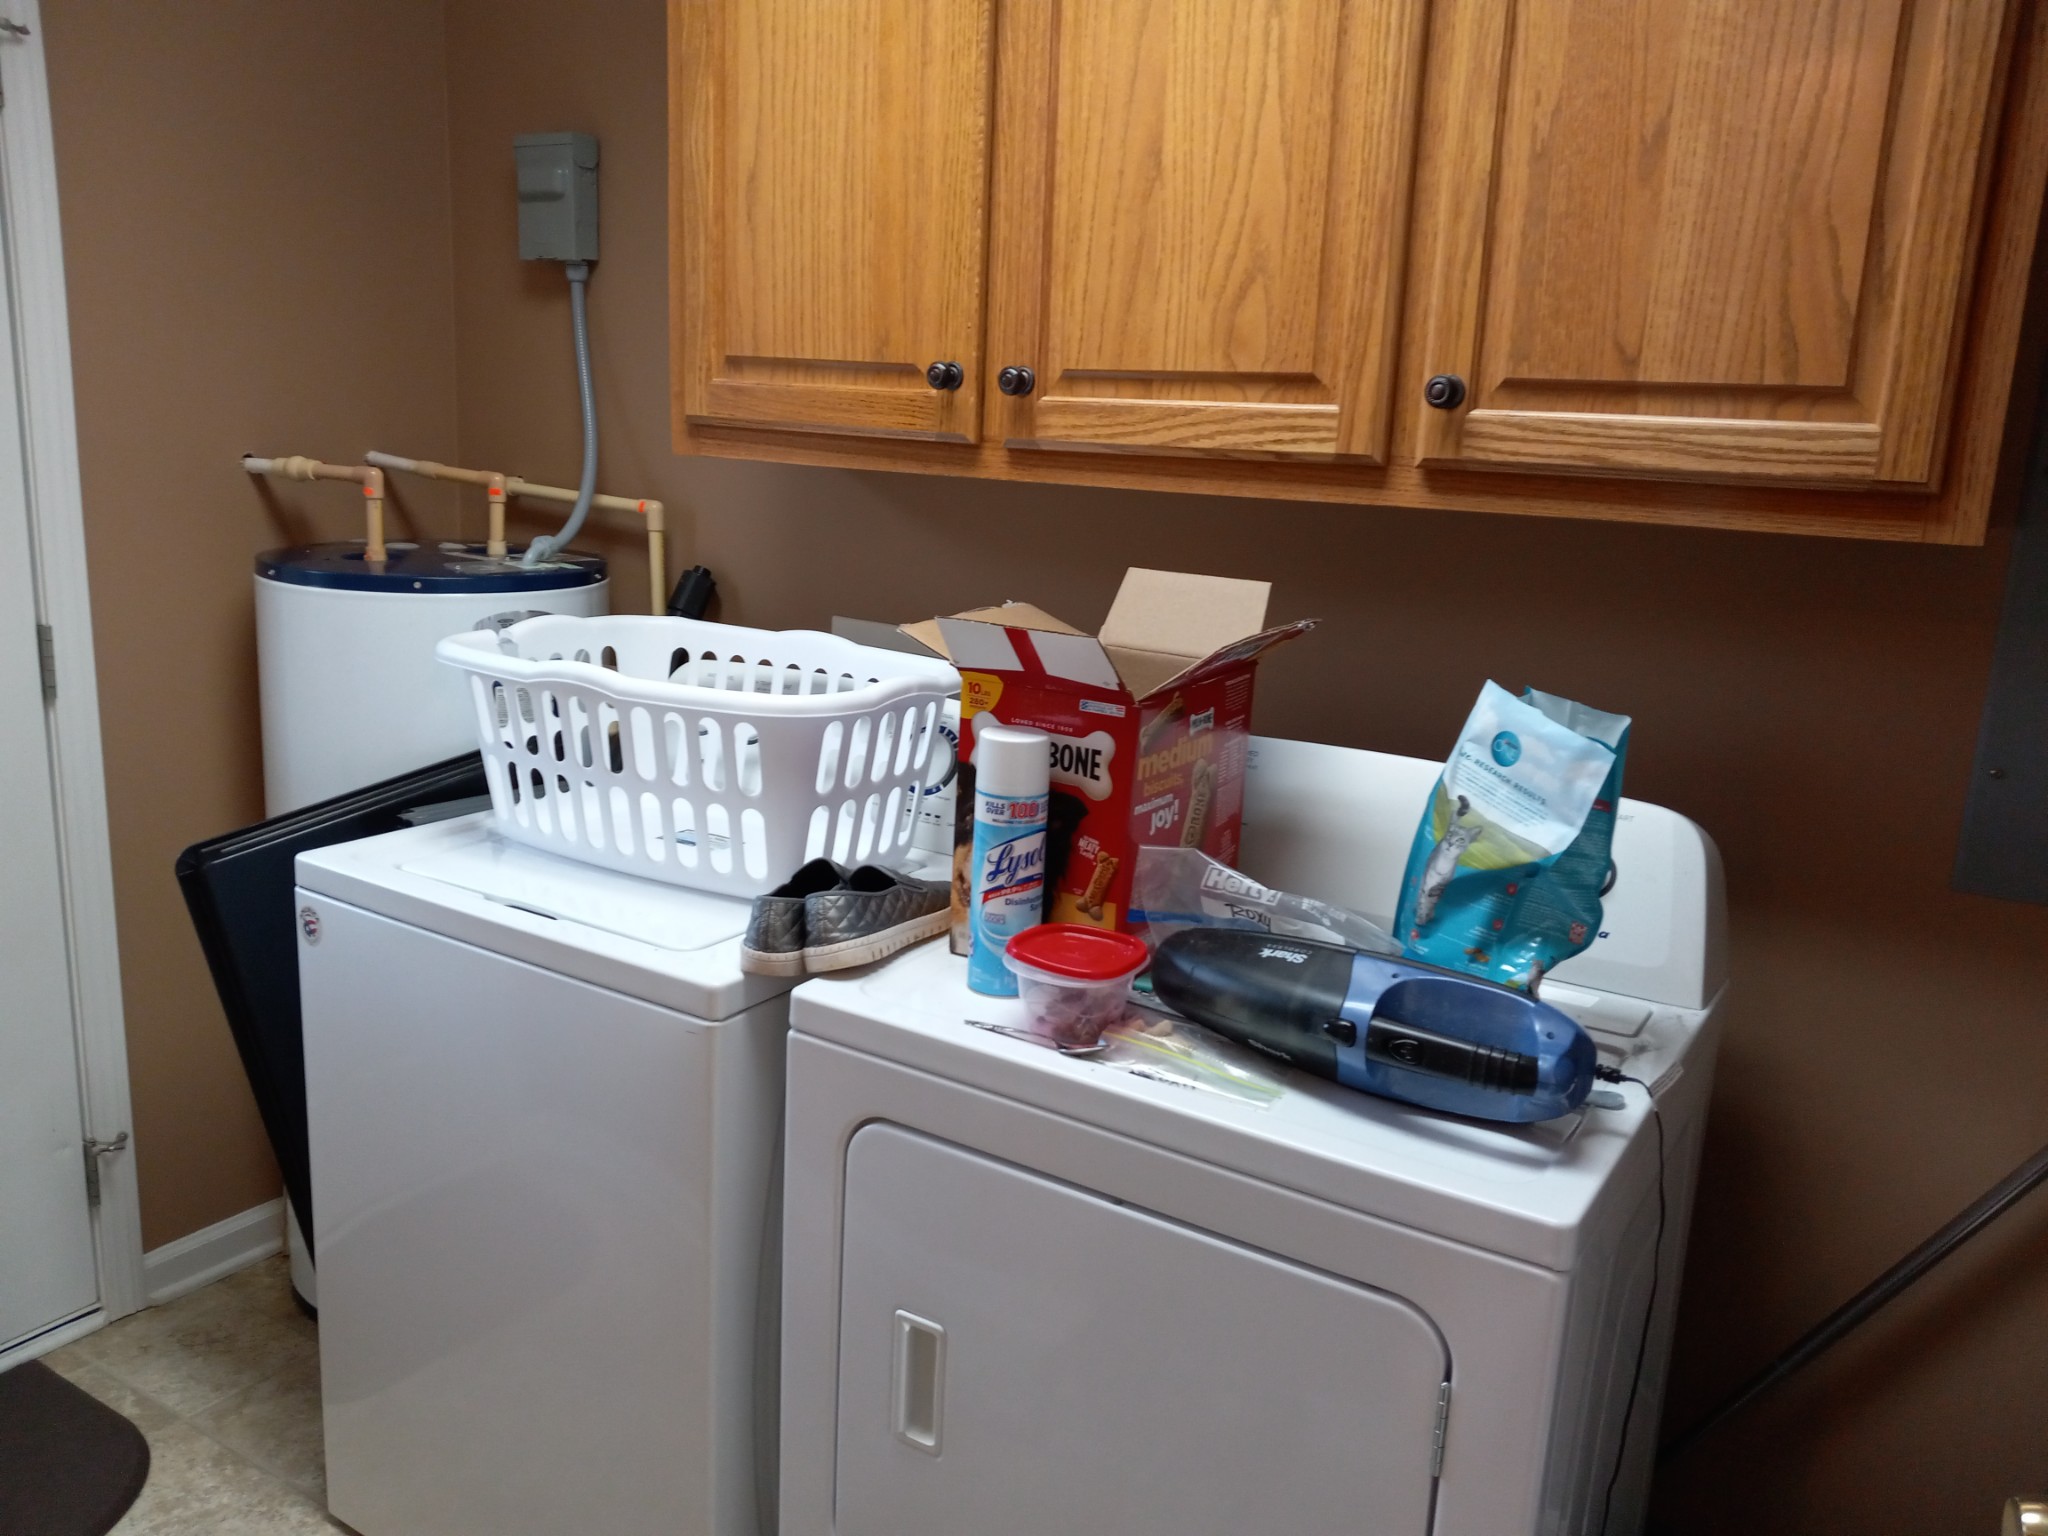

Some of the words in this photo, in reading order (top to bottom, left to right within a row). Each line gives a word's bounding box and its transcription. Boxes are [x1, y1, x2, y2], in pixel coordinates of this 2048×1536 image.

[968, 681, 981, 695] 10
[1035, 721, 1056, 730] SINCE
[1137, 733, 1213, 781] medium
[985, 801, 1005, 810] KILLS
[986, 807, 1005, 816] OVER
[1008, 801, 1040, 819] 100
[1149, 798, 1179, 836] joy!
[986, 835, 1046, 885] Lysol
[1258, 947, 1309, 964] Shark
